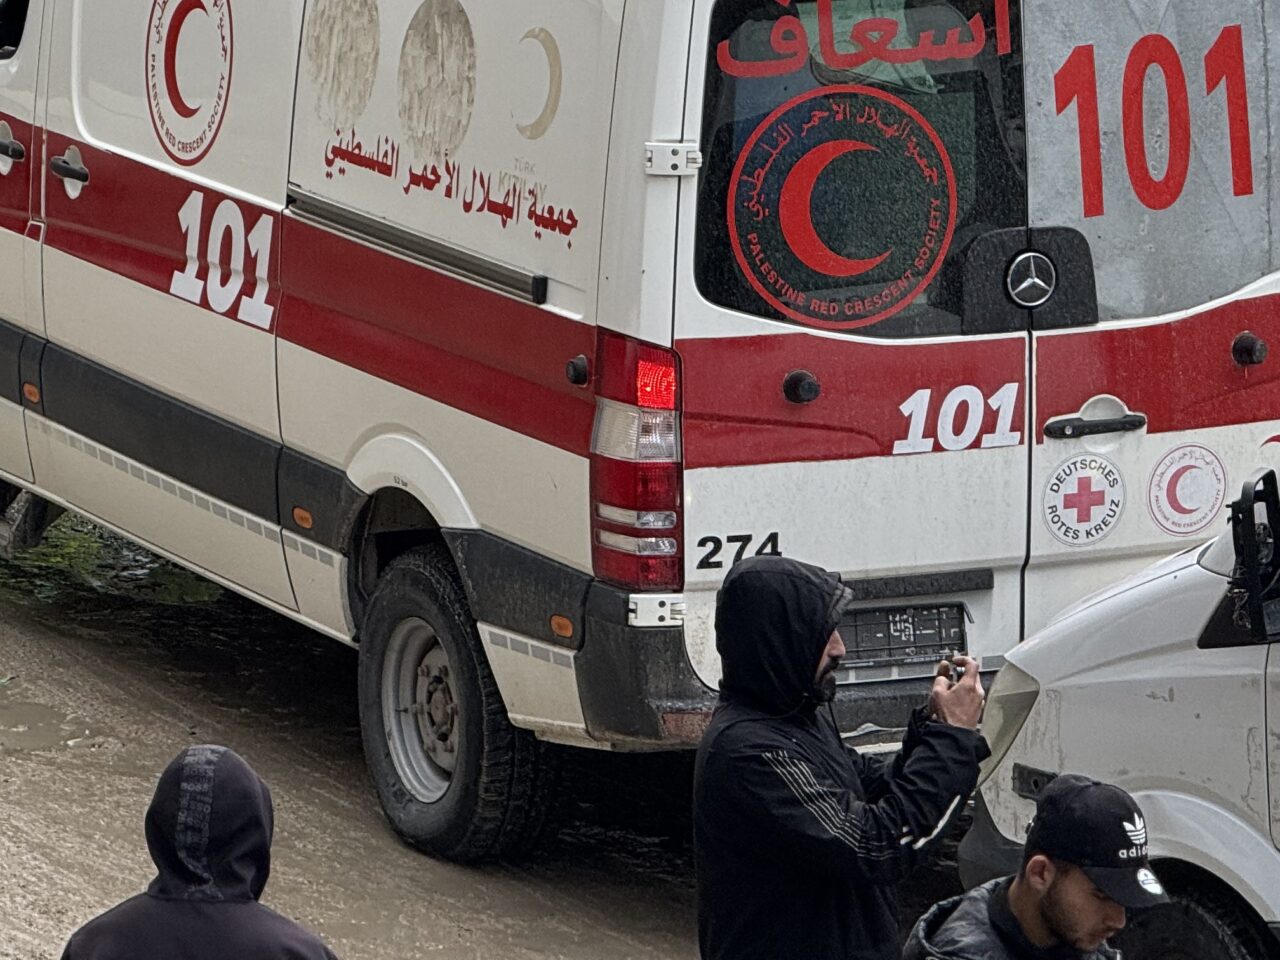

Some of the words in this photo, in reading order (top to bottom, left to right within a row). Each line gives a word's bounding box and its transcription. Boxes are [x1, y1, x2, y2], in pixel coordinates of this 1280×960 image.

[151, 53, 166, 130] PALESTINE
[165, 127, 177, 148] RED
[177, 129, 207, 154] CRESCENT
[207, 72, 225, 132] SOCIETY
[1053, 23, 1255, 219] 101
[324, 127, 400, 181] الفلسطيني
[402, 147, 461, 200] الأحمر
[463, 164, 521, 230] الهلال
[527, 187, 579, 250] جمعية
[169, 190, 275, 330] 101
[747, 232, 807, 307] PALESTINE
[809, 300, 839, 316] RED
[844, 271, 915, 316] CRESCENT
[914, 198, 941, 270] SOCIETY
[892, 382, 1021, 455] 101
[1049, 458, 1119, 494] DEUTSCHES
[695, 531, 783, 570] 274
[1047, 505, 1080, 540] ROTES
[1085, 499, 1121, 539] KREUZ
